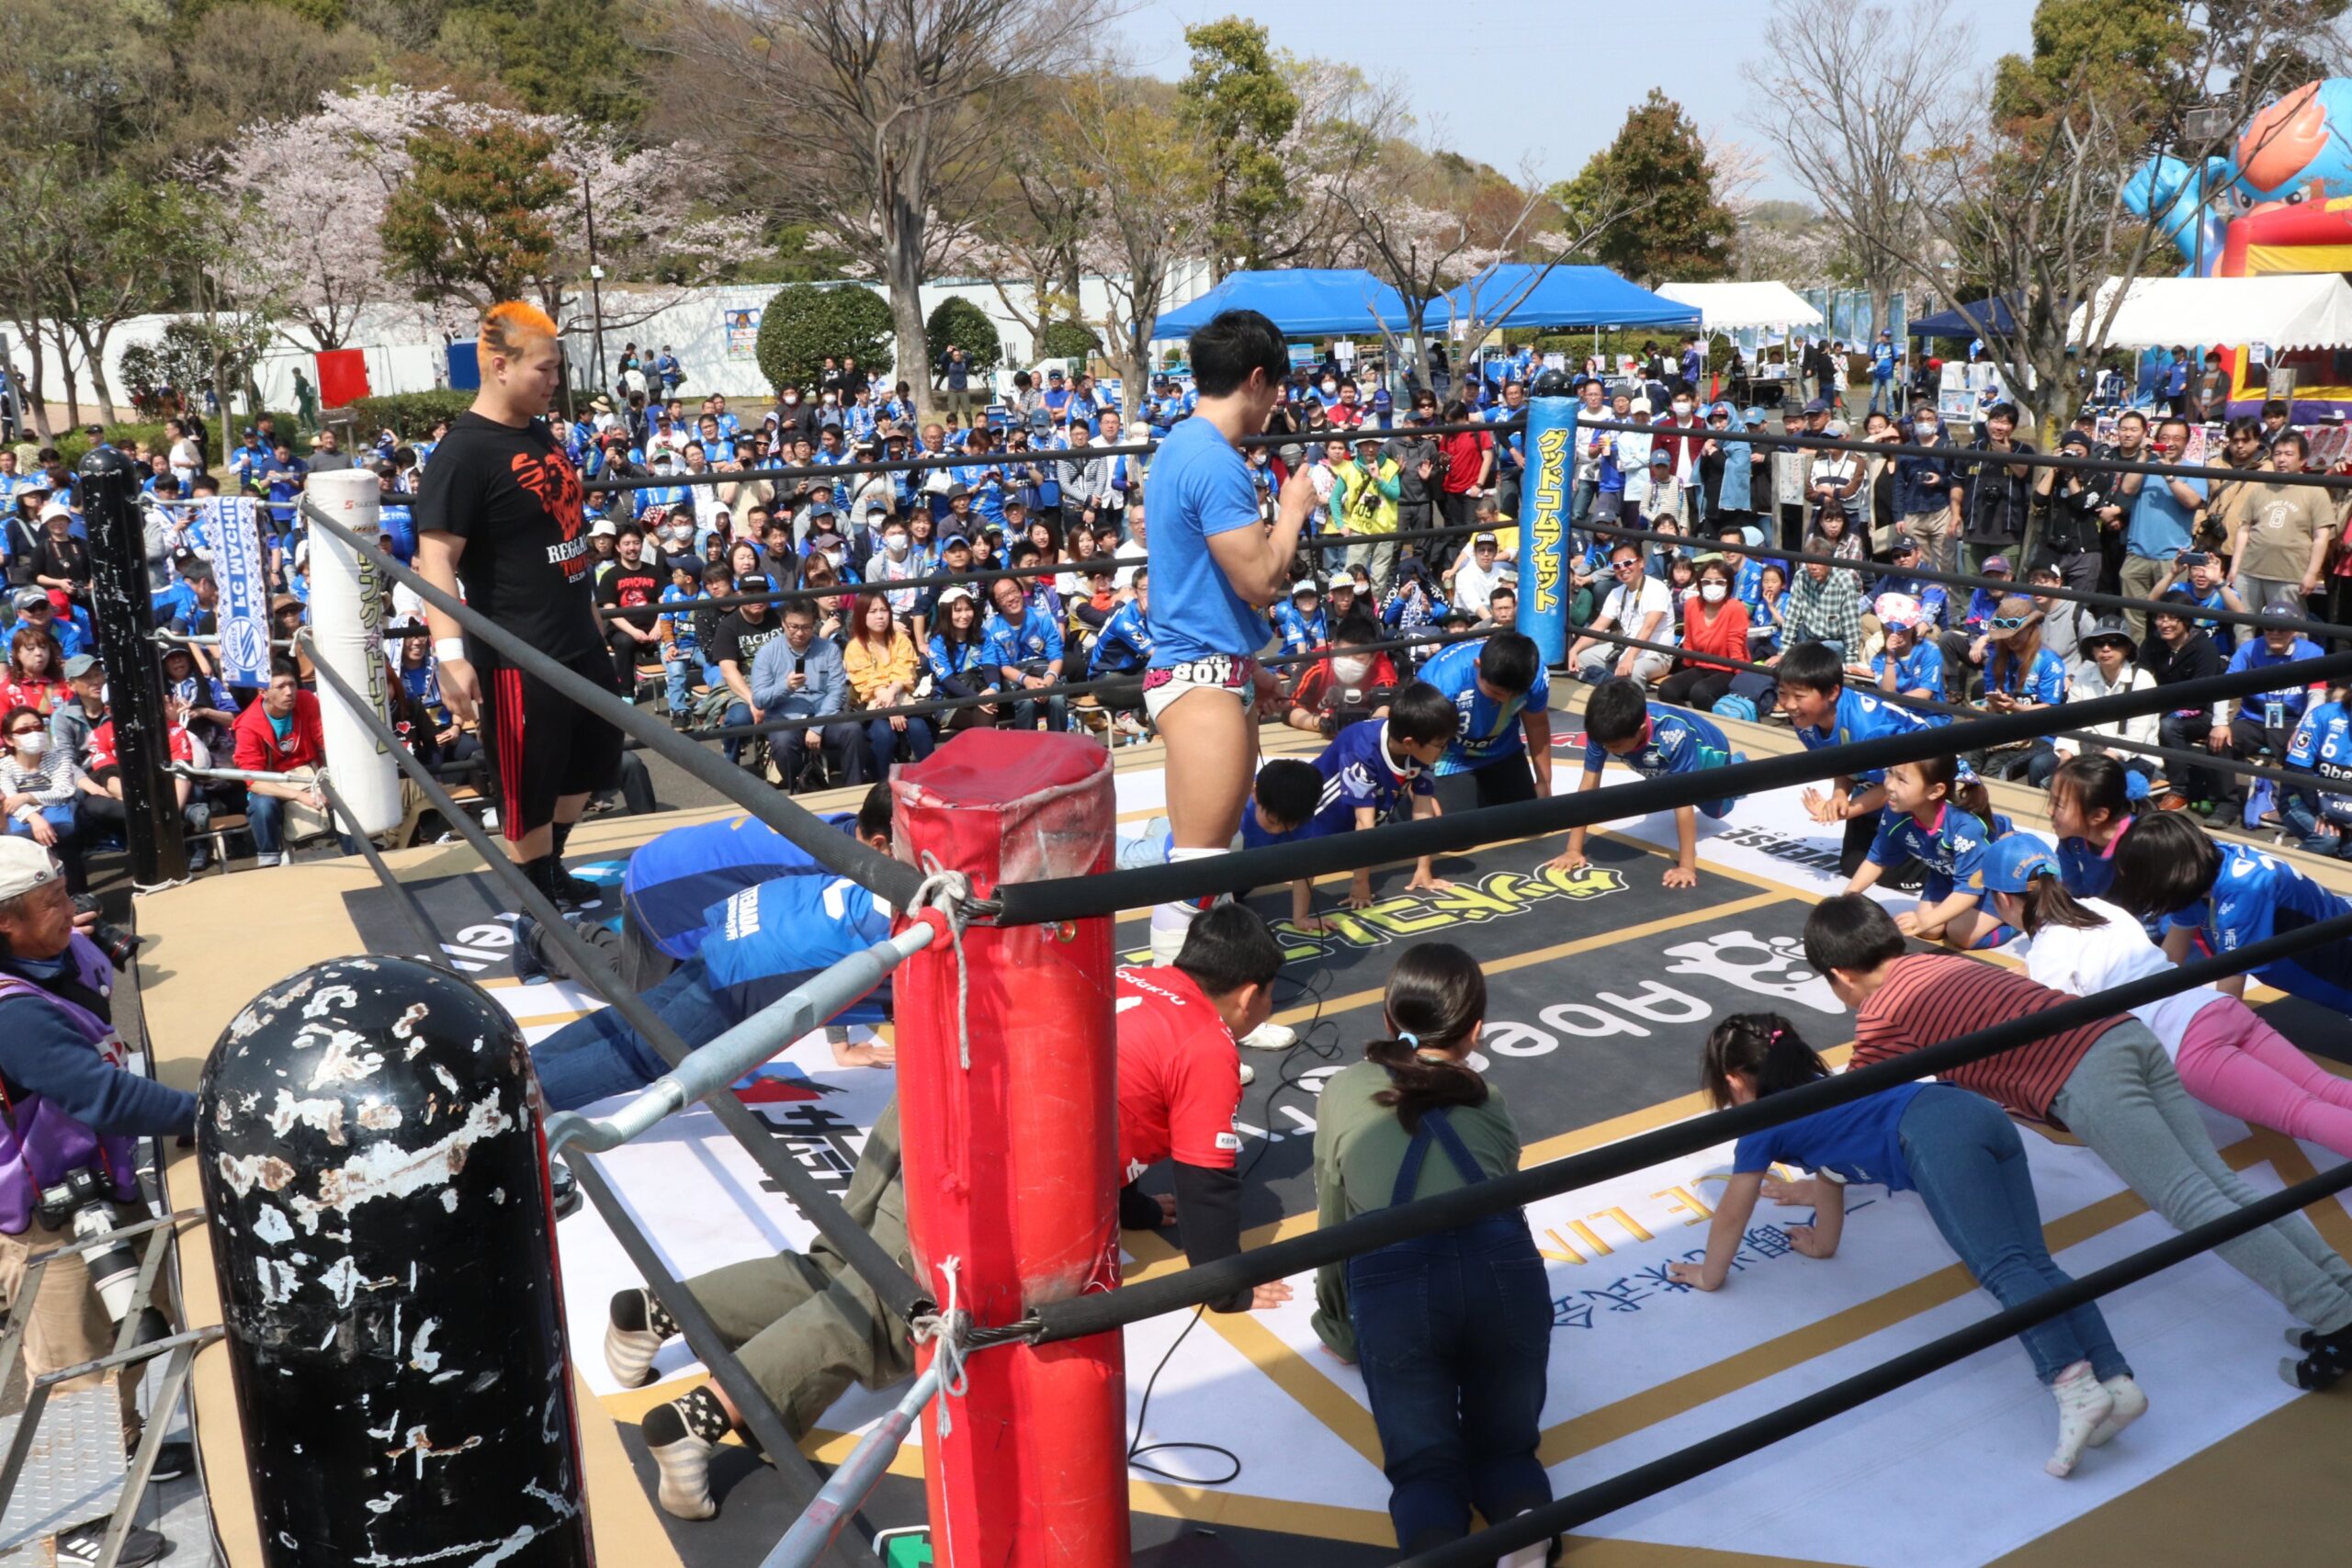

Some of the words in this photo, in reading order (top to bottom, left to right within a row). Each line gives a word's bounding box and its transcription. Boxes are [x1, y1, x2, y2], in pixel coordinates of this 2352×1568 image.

[1532, 428, 1568, 613] グッドコムアセット
[1172, 661, 1232, 683] BOX
[2320, 734, 2340, 758] 6
